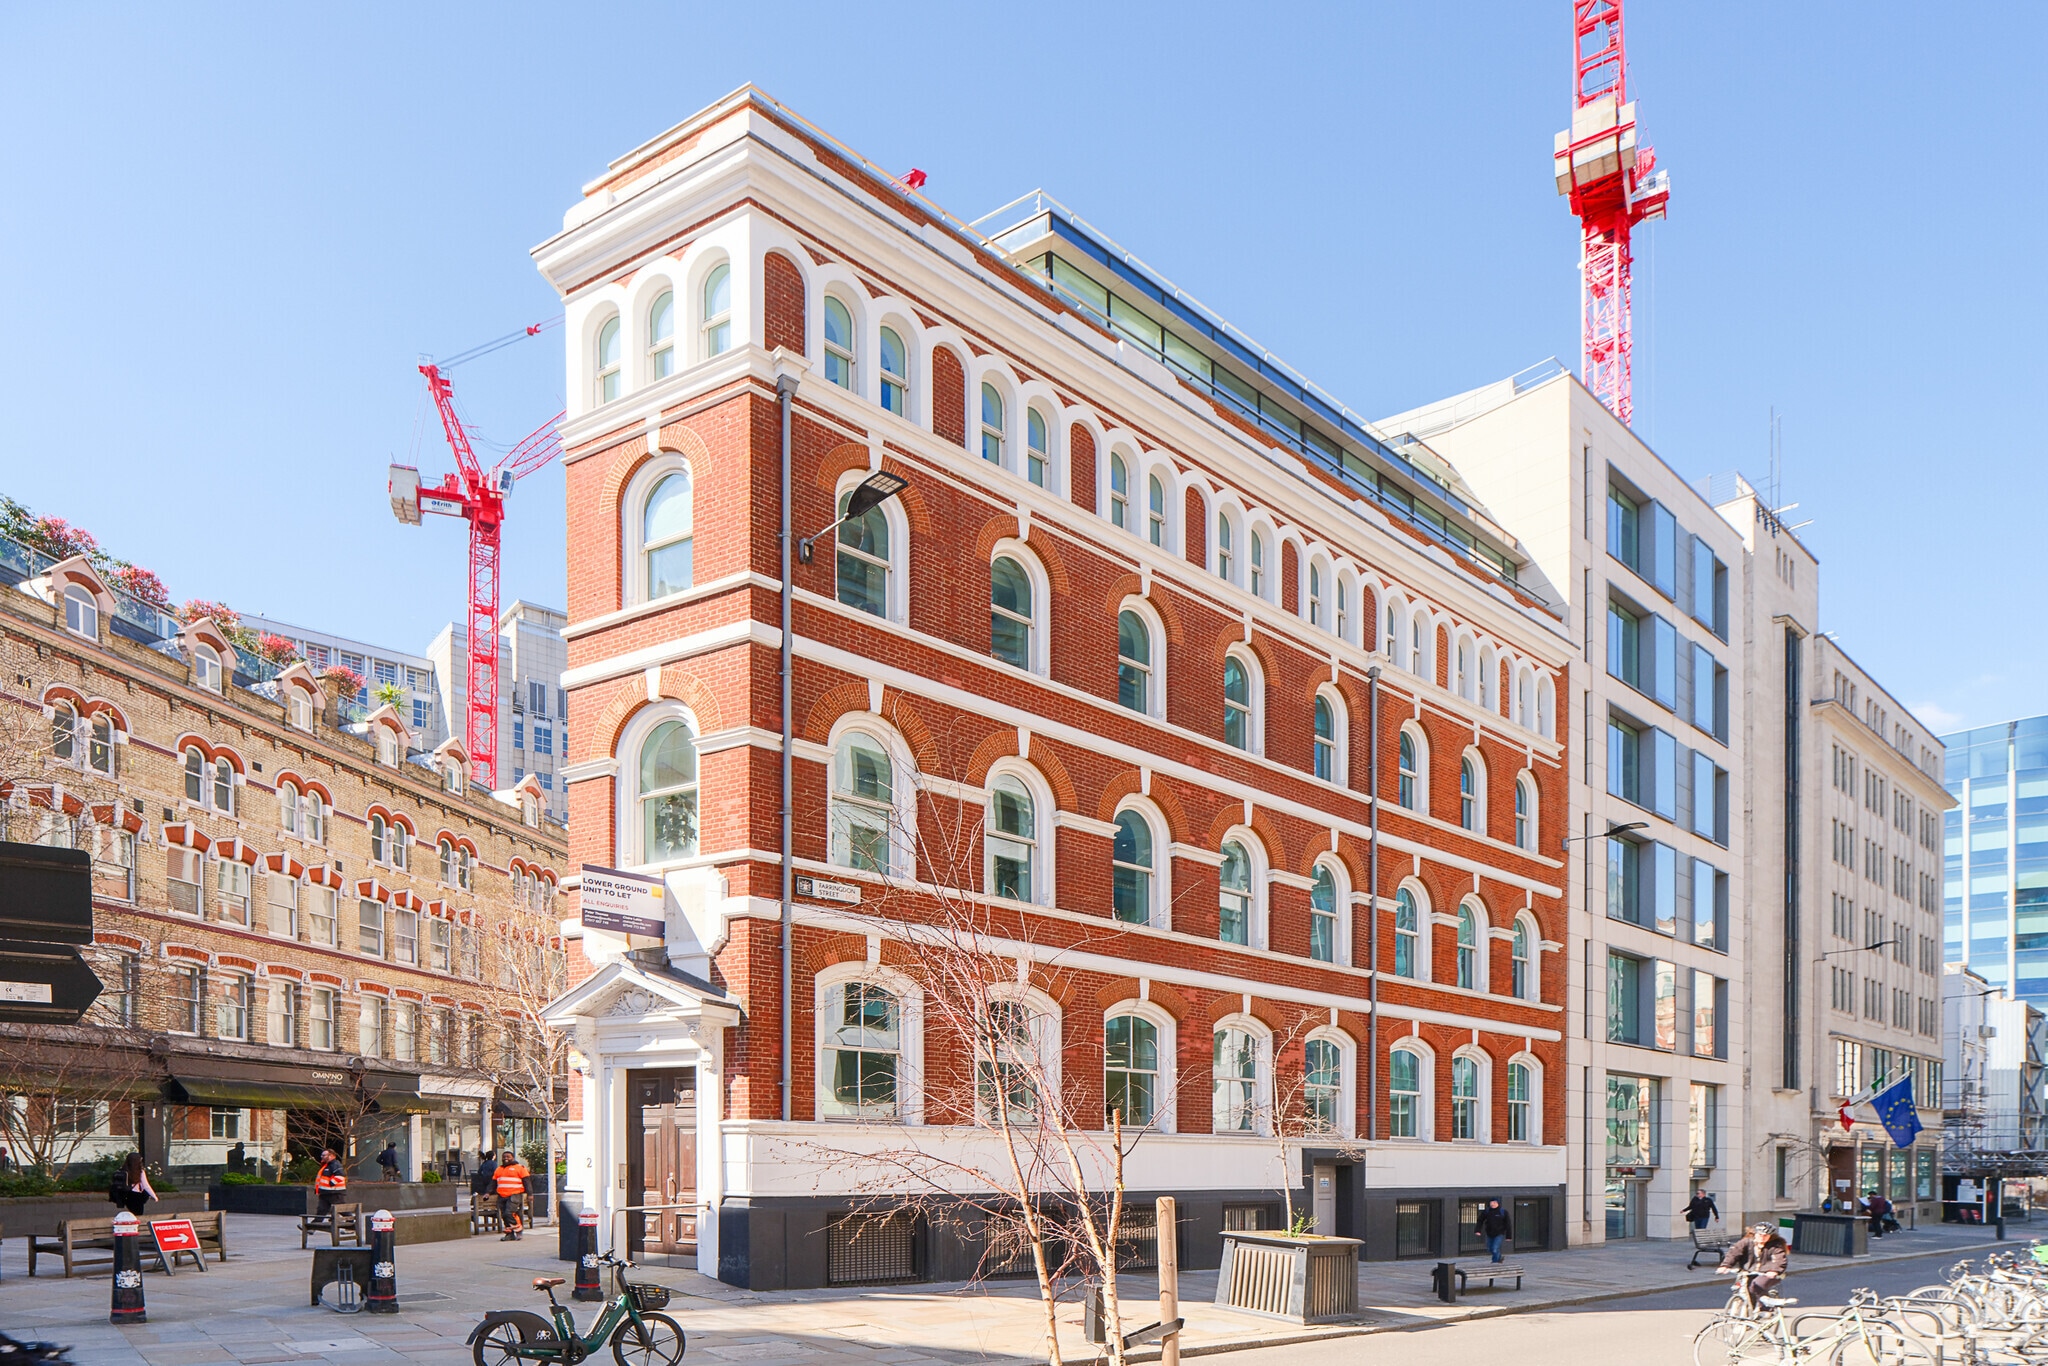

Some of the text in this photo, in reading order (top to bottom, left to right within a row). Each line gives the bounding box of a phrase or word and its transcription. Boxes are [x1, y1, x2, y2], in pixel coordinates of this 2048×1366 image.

[583, 877, 648, 894] LOWER GROUND
[583, 885, 602, 894] UNIT
[604, 889, 615, 897] TO
[818, 883, 856, 894] FARRINGDON
[819, 890, 839, 898] STREET
[596, 901, 629, 910] ENQUIRIES
[586, 1157, 592, 1168] 2
[155, 1223, 190, 1231] PEDESTRIANS
